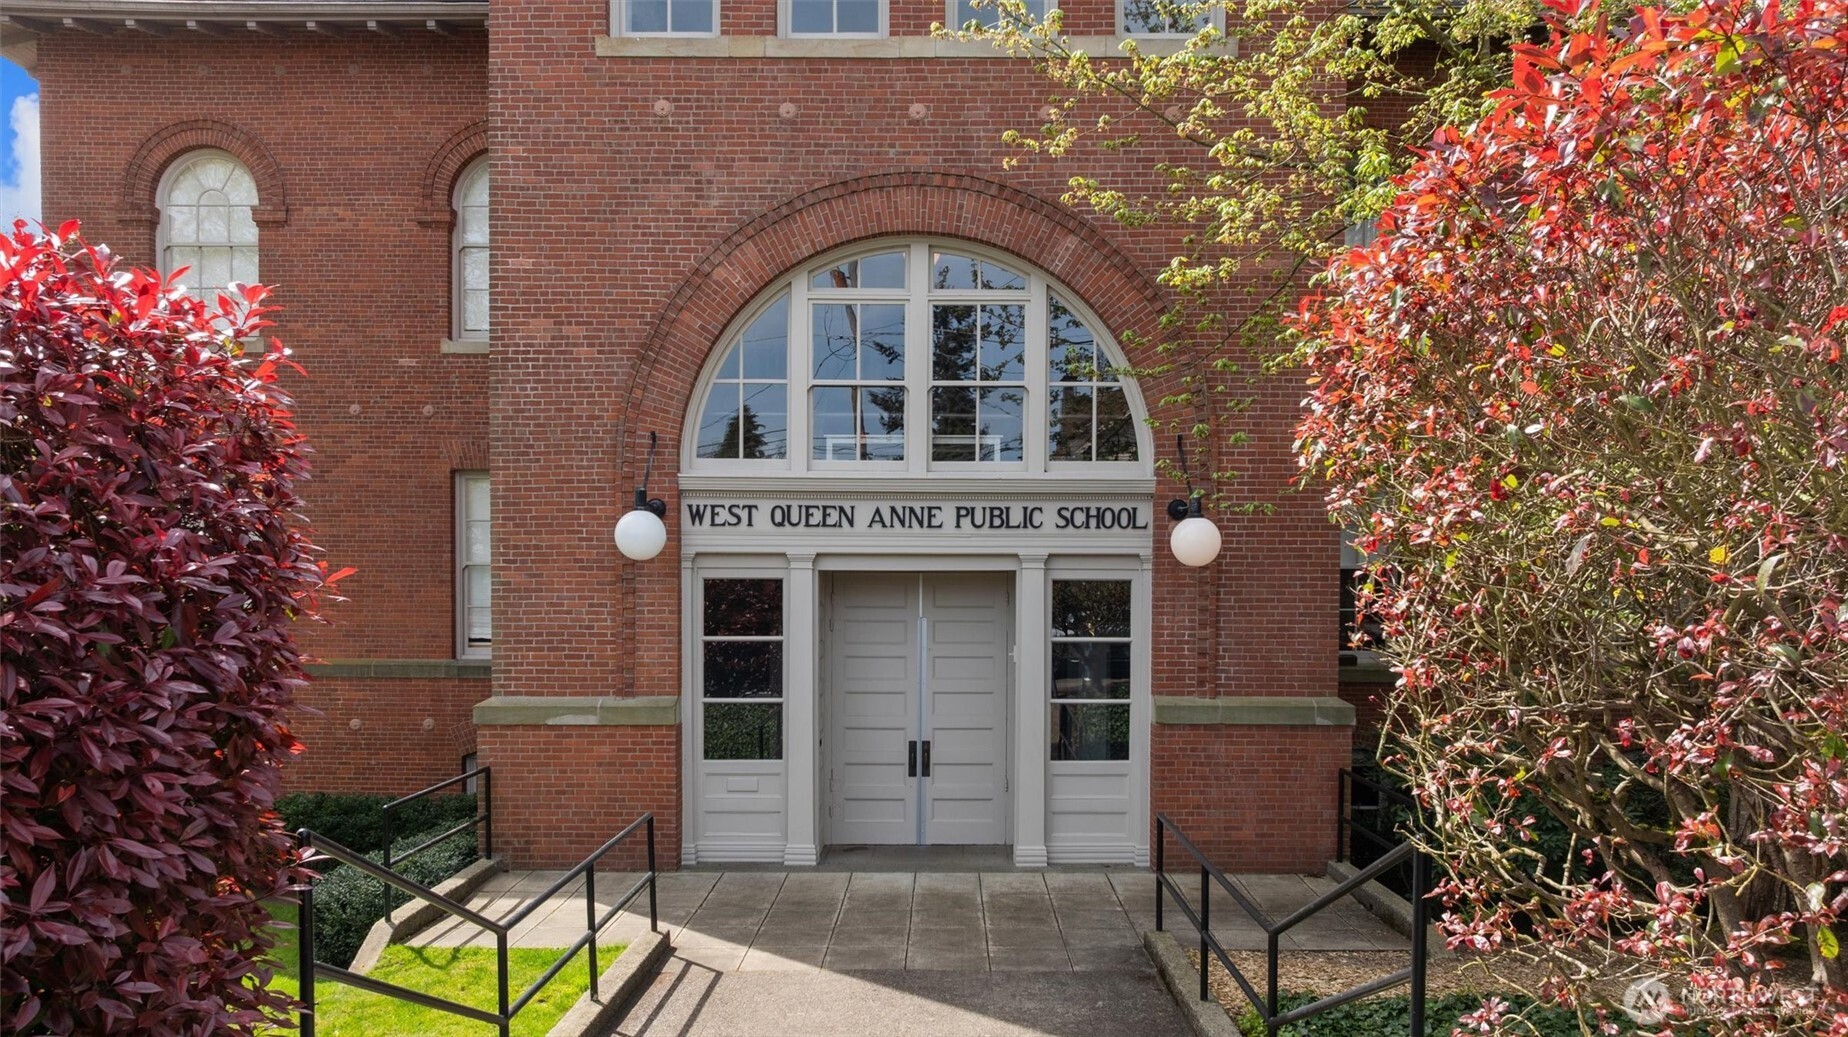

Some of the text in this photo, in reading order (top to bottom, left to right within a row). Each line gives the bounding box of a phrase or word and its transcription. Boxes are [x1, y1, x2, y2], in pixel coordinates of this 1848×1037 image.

[686, 504, 1148, 530] WEST QUEEN ANNE PUBLIC SCHOOL
